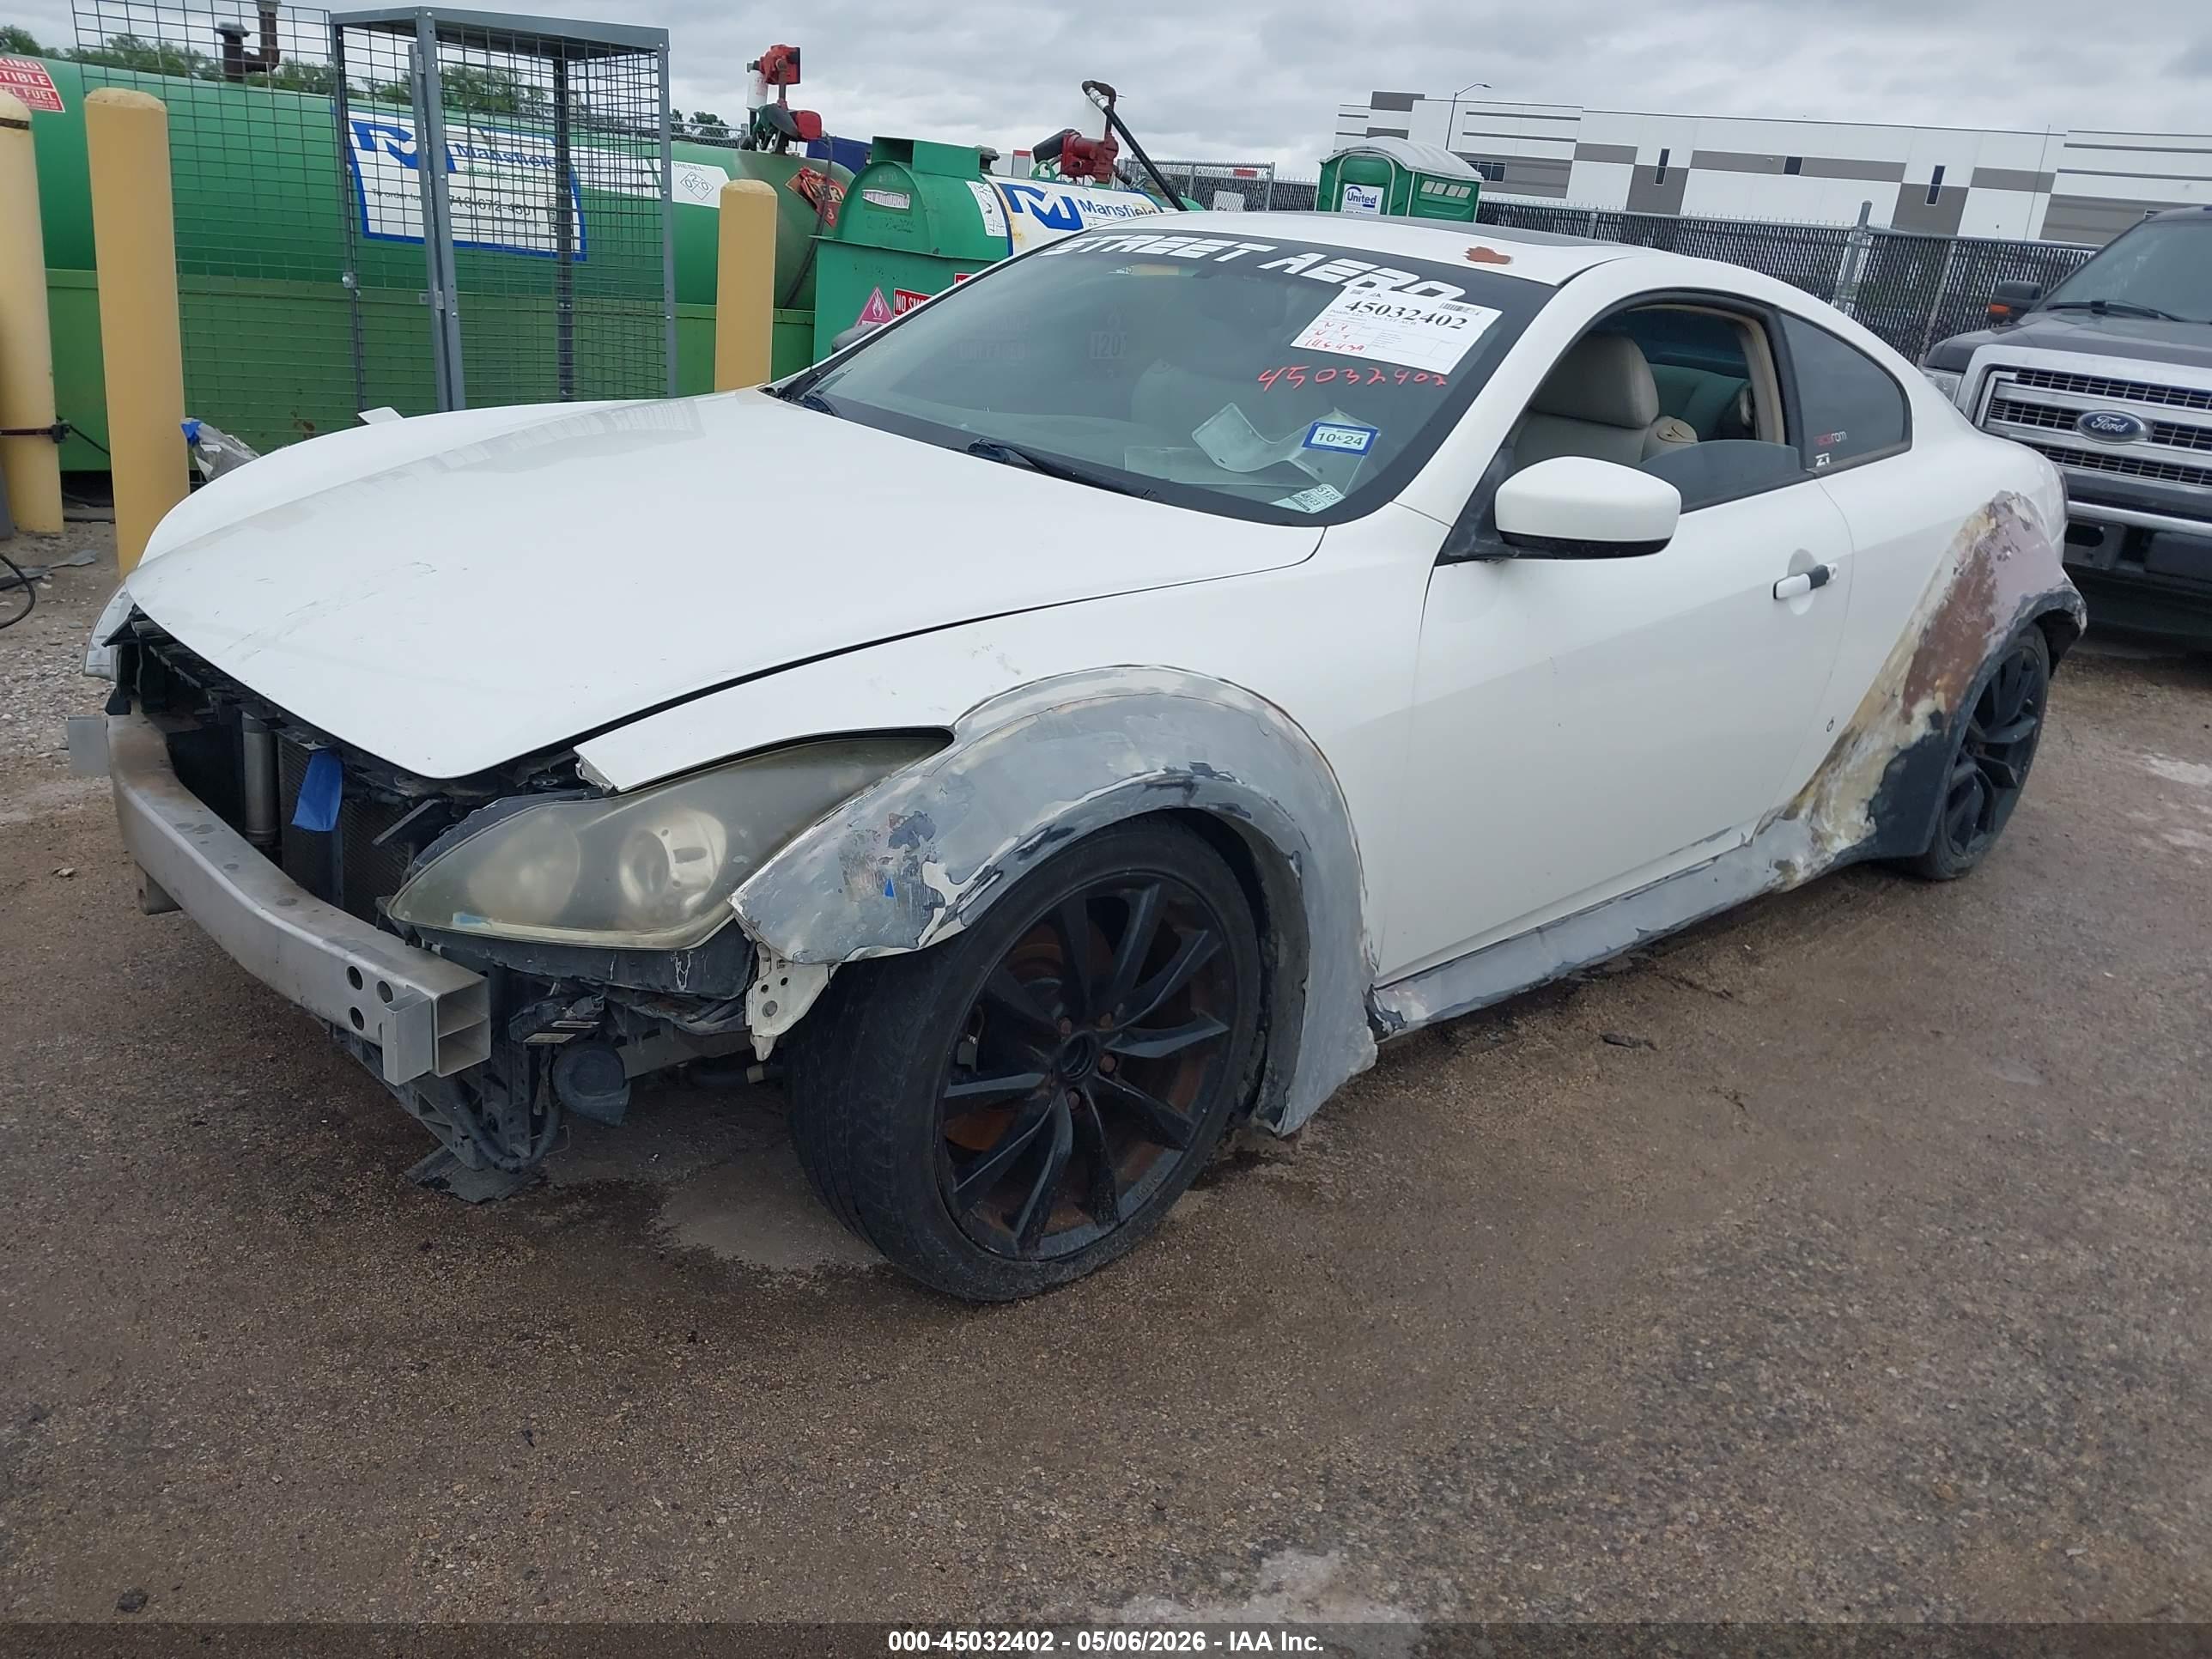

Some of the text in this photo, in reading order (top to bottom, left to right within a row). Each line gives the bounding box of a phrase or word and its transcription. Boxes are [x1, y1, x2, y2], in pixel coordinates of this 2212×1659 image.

[0, 70, 49, 86] TIBLE
[24, 88, 57, 101] FUEL
[673, 161, 704, 172] DIESEL
[1346, 191, 1377, 204] United
[1078, 198, 1157, 218] Mansfield
[1039, 234, 1466, 301] STREET AERO
[896, 294, 907, 312] NO
[1345, 301, 1468, 330] 45032402
[1257, 365, 1448, 392] 45032402
[2091, 415, 2129, 433] Ford
